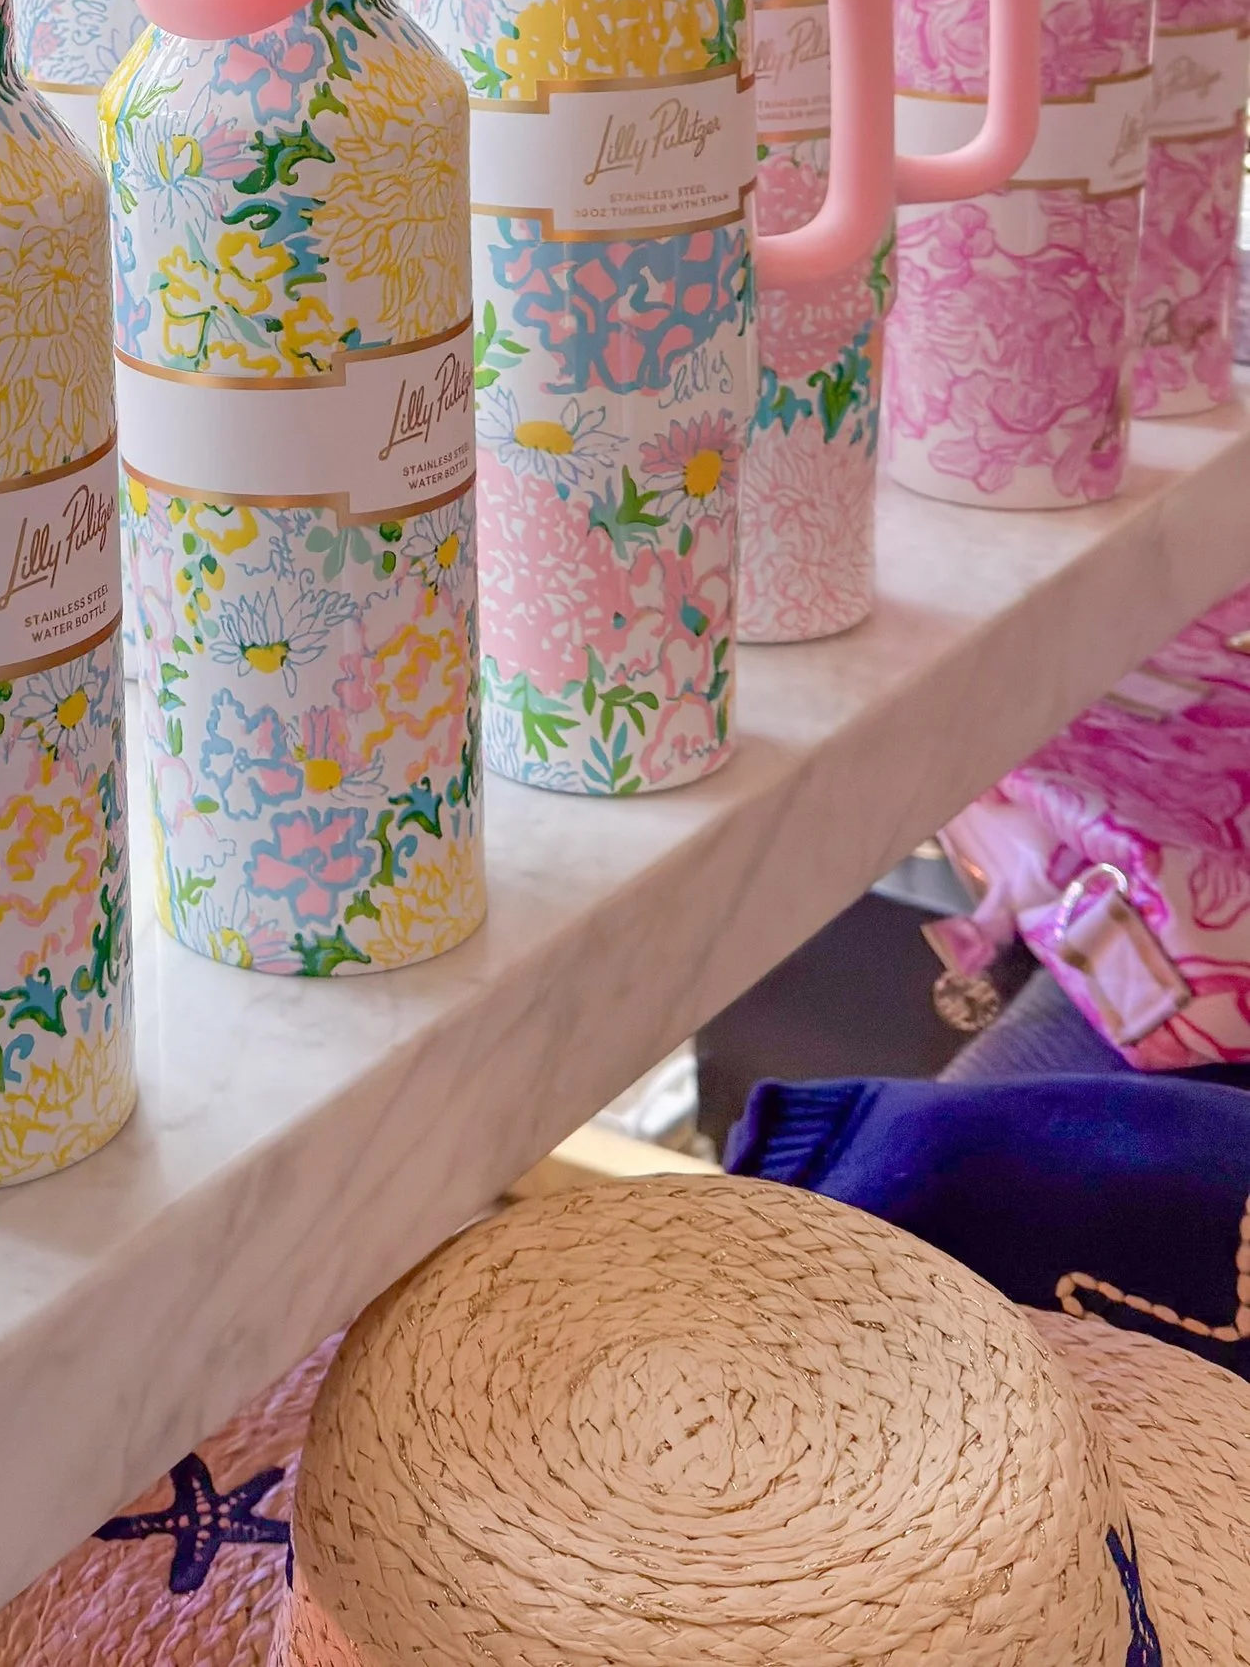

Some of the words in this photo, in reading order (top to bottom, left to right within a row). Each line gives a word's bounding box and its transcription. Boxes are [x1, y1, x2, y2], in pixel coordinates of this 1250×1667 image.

[583, 113, 649, 186] Lilly
[649, 97, 722, 158] Pulitzer
[378, 378, 433, 462] Lilly
[402, 451, 453, 477] STAINLESS
[408, 471, 444, 490] WATER
[62, 483, 116, 566] Pulitzer
[24, 597, 86, 629] STAINLESS
[86, 583, 110, 606] STEEL
[31, 619, 74, 644] WATER
[75, 600, 108, 627] BOTTLE
